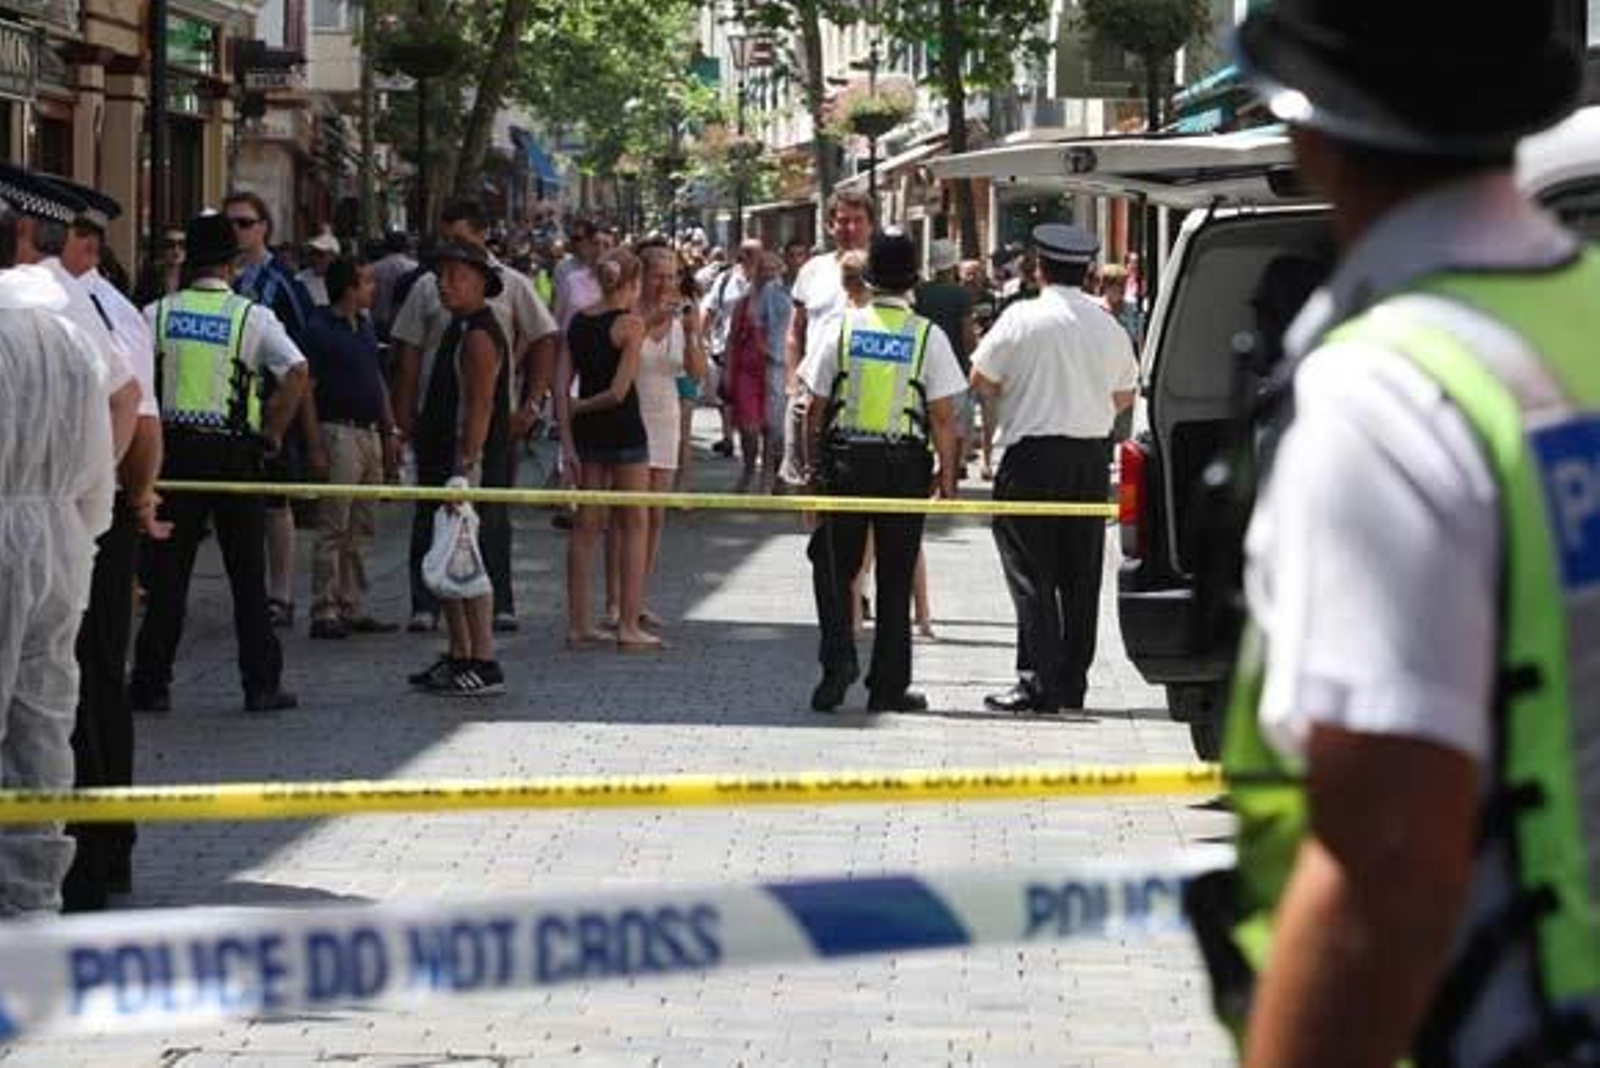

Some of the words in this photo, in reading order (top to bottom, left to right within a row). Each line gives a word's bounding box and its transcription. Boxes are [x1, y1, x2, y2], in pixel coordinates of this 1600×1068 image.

[169, 314, 230, 340] POLICE
[853, 332, 910, 358] POLICE
[66, 934, 289, 1015] POLICE
[306, 926, 387, 1000] DO
[404, 916, 517, 991] NOT
[534, 903, 723, 984] CROSS
